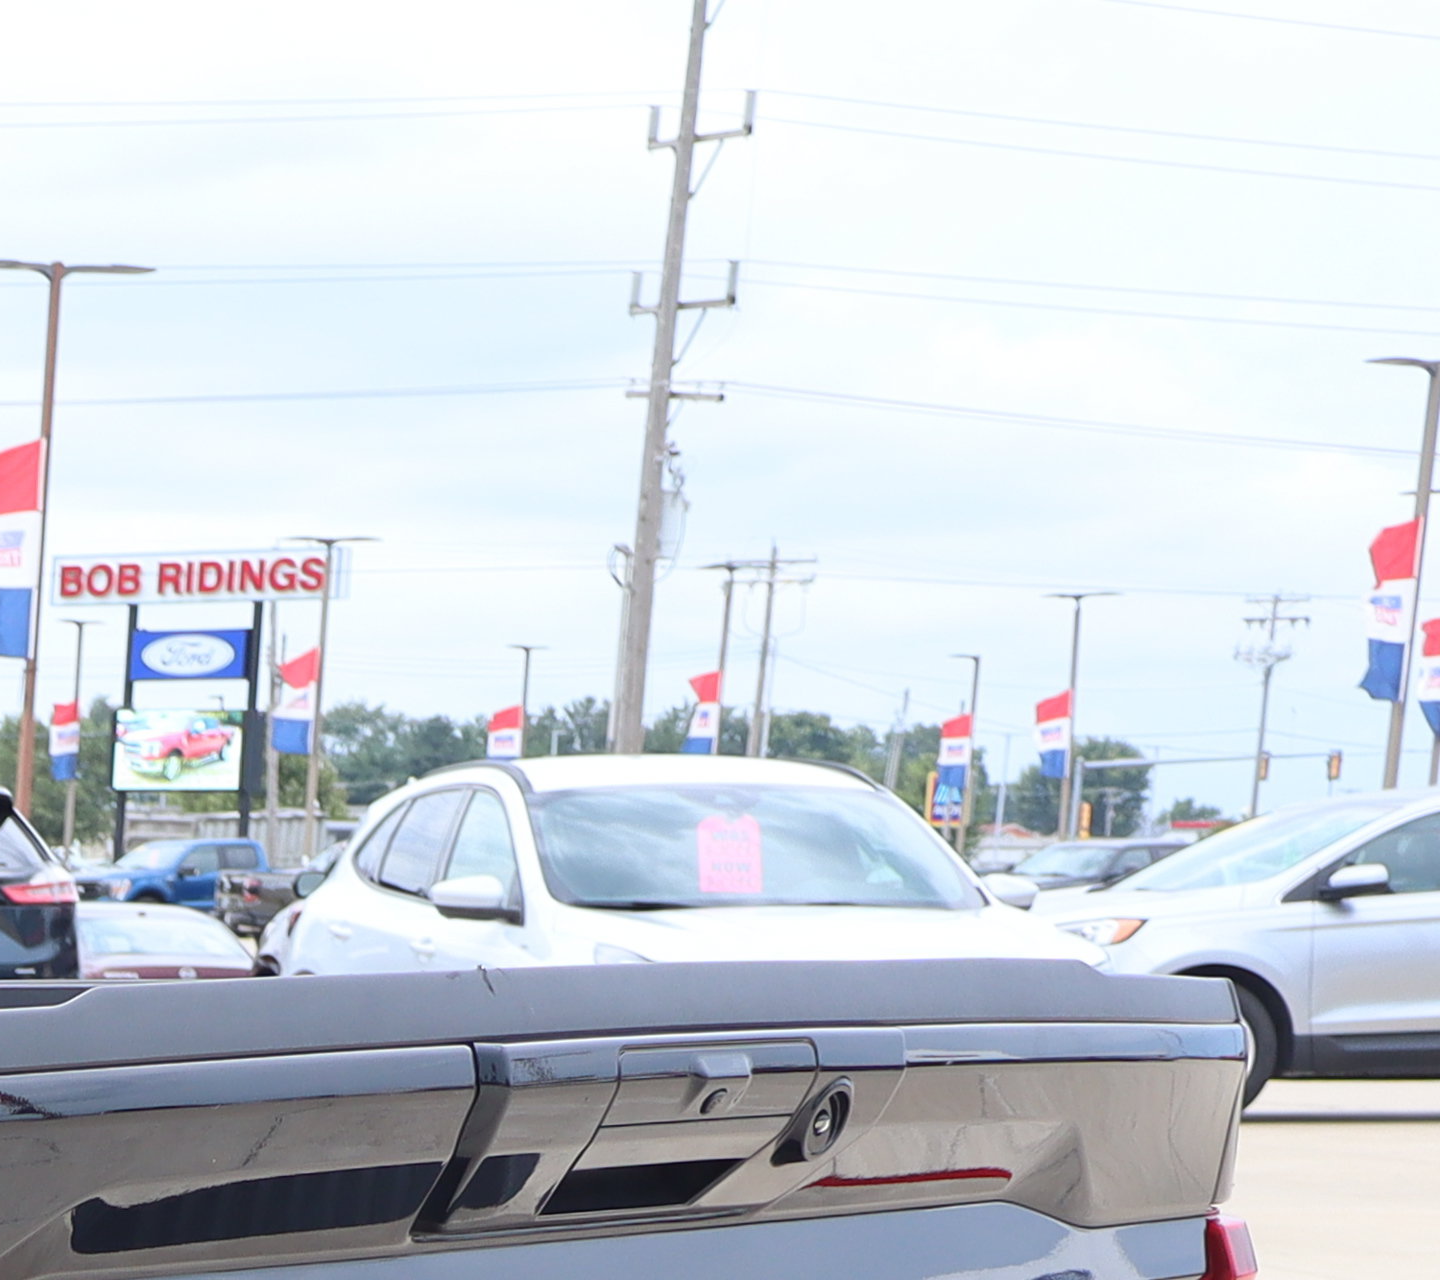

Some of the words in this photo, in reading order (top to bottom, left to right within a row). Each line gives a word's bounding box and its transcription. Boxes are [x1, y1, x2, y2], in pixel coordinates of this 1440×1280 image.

[60, 563, 142, 598] BOB
[157, 557, 328, 595] RIDINGS
[160, 642, 216, 667] Ford
